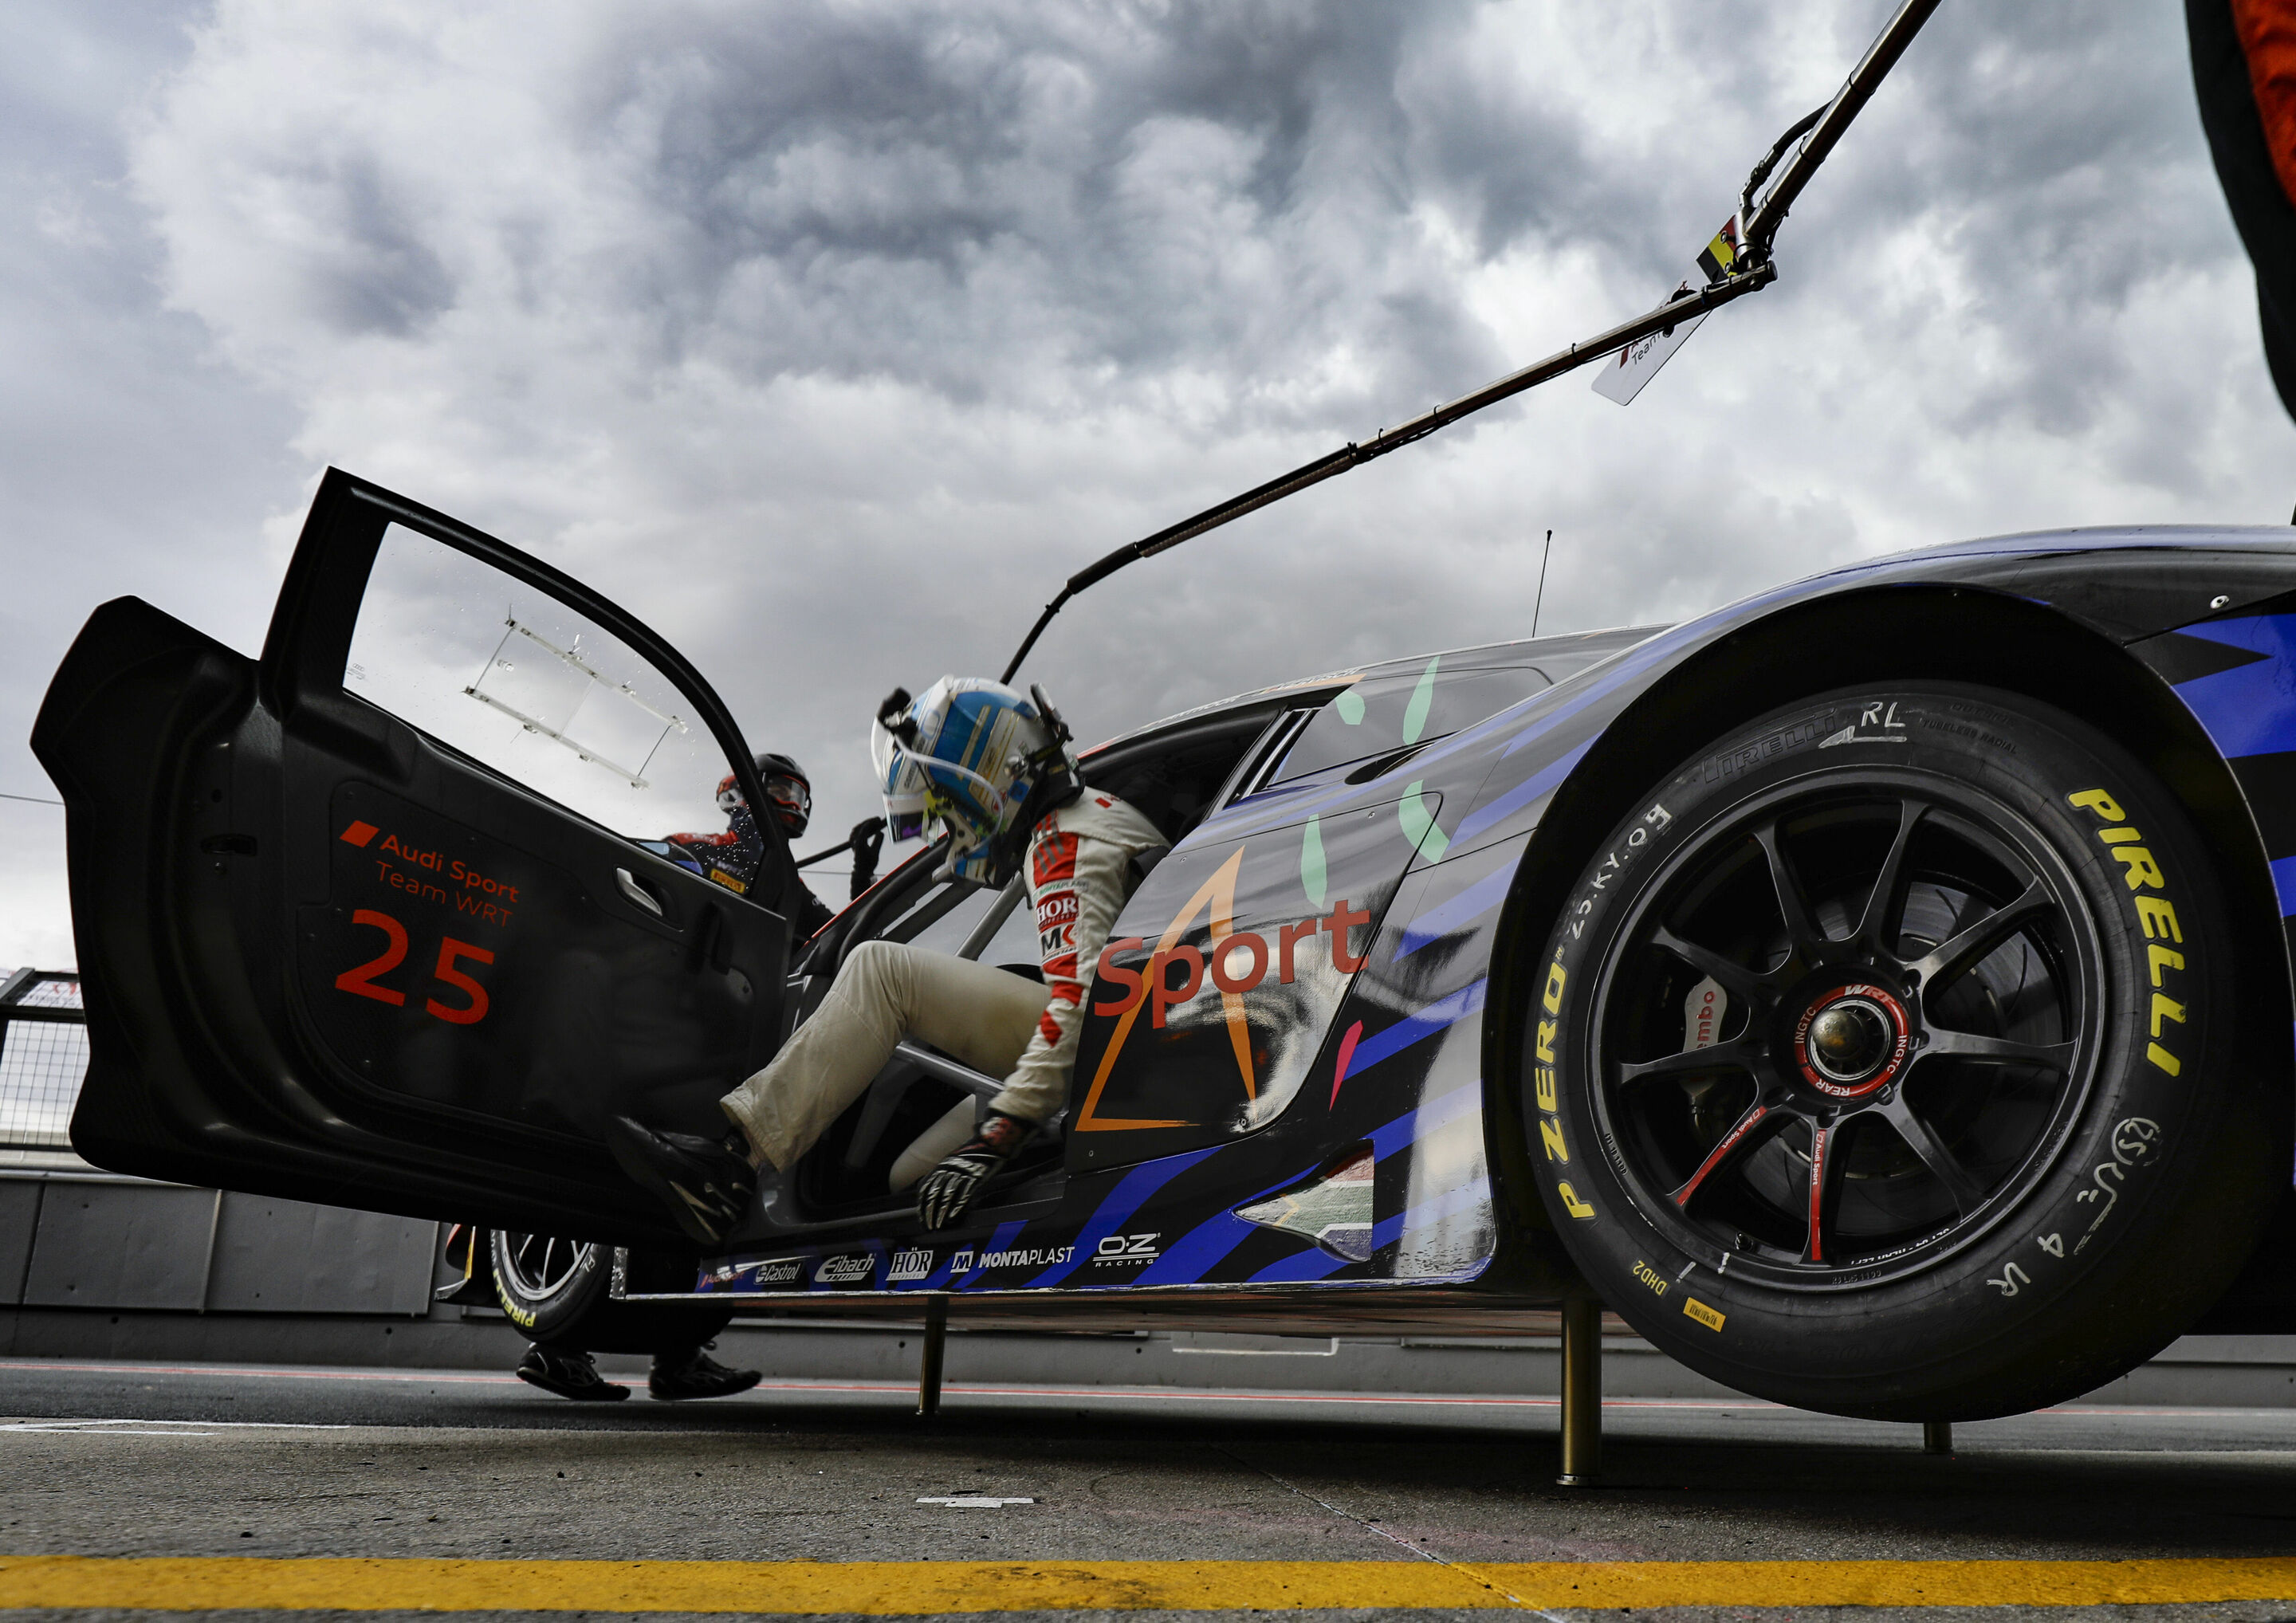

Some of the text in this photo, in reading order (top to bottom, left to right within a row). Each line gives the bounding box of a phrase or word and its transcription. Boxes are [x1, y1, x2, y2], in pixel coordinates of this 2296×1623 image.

[1861, 701, 1906, 728] RL
[379, 835, 520, 903] Audi Sport
[376, 860, 513, 927] Team WRT
[2068, 788, 2187, 1077] PIRELLI
[335, 909, 495, 1025] 25
[1094, 899, 1370, 1030] Sport
[1844, 984, 1895, 1004] WRT
[1795, 1006, 1817, 1044] INGTC
[1886, 1034, 1908, 1074] INGTC
[1535, 961, 1595, 1219] P ZERO
[1815, 1078, 1850, 1097] REAR
[764, 1263, 800, 1283] Castrol
[815, 1253, 875, 1282] Eibach
[890, 1246, 930, 1273] HÖR
[978, 1247, 1075, 1268] MONTAPLAST
[1095, 1258, 1154, 1268] RACING
[1632, 1259, 1668, 1296] DHD2
